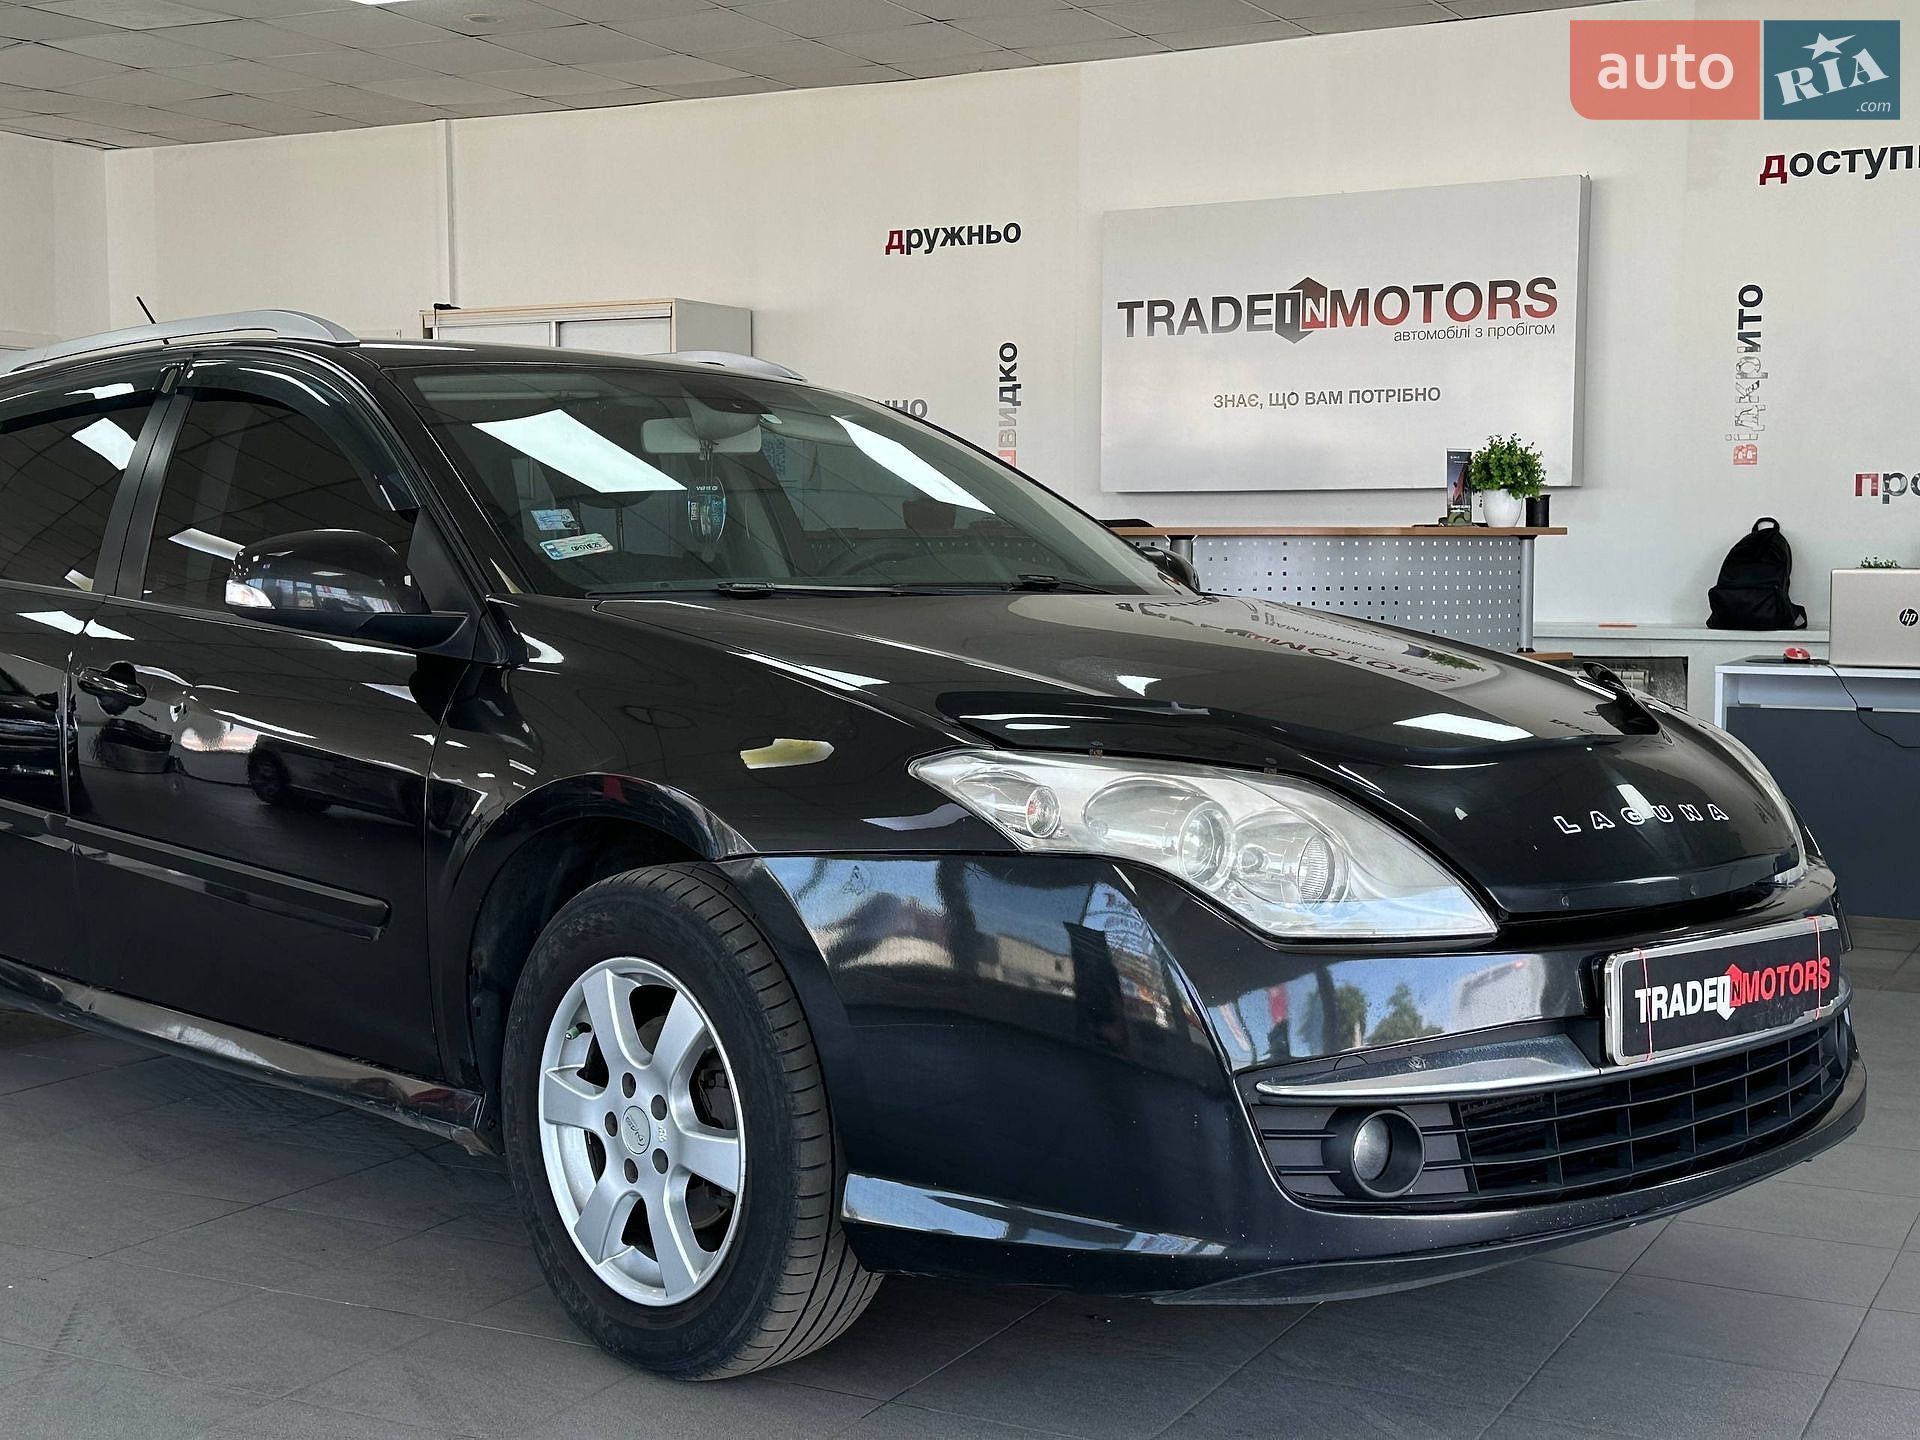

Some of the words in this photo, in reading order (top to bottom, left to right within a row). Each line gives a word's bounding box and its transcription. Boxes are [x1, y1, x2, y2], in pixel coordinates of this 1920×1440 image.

[1759, 145, 1920, 186] доступ
[885, 222, 1022, 255] дружньо
[1393, 324, 1471, 342] автомобілі
[1474, 328, 1484, 338] з
[1487, 322, 1555, 340] пробігом
[1213, 393, 1264, 410] ЗНАЄ,
[1268, 391, 1300, 410] ЩО
[1304, 390, 1343, 406] ВАМ
[1348, 387, 1441, 405] ПОТРІБНО
[1553, 803, 1730, 834] LAGUNA
